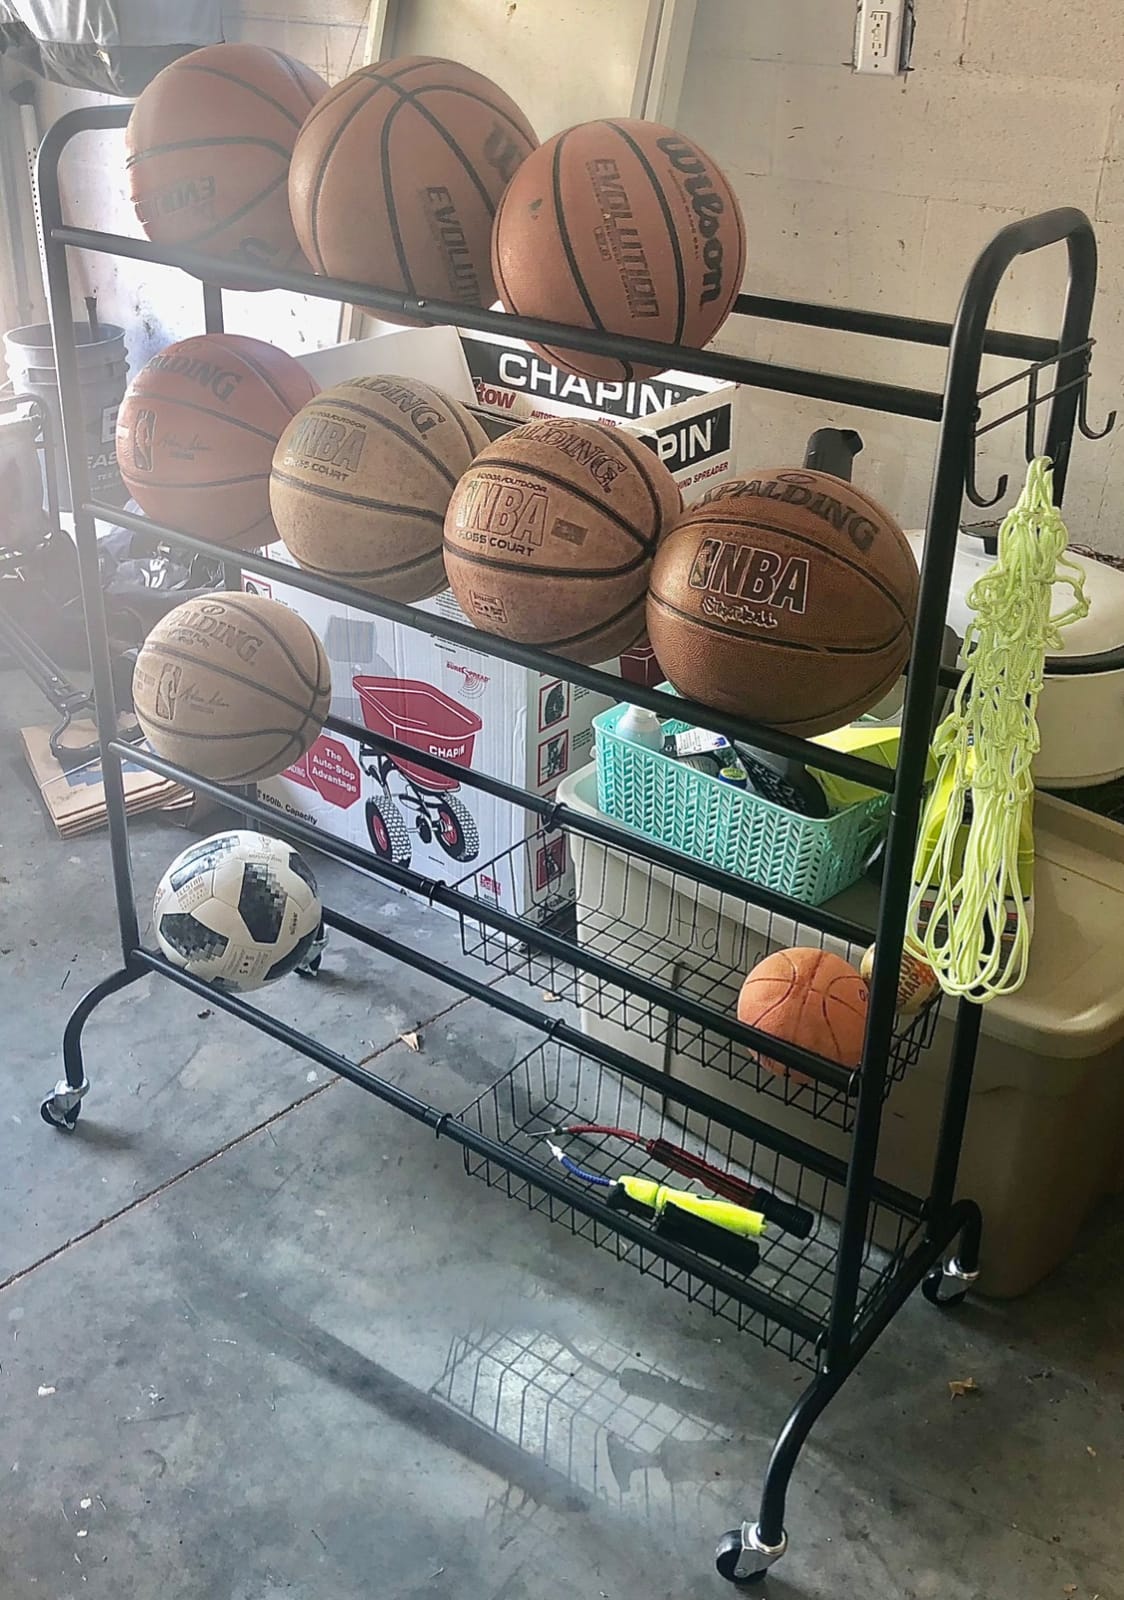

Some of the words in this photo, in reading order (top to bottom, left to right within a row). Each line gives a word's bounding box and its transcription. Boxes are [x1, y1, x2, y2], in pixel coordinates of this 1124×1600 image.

[593, 158, 660, 317] EVOLUTION
[499, 352, 673, 417] CHAPIN
[299, 417, 368, 473] NBA
[694, 461, 729, 483] SPREADER
[471, 481, 549, 546] NBA
[490, 536, 535, 557] COURT
[709, 542, 810, 614] NBA
[324, 747, 342, 761] The
[429, 744, 465, 759] CHAPIN
[312, 766, 357, 793] Advantage
[313, 755, 356, 780] Auto-Stop
[285, 803, 318, 825] Capacity
